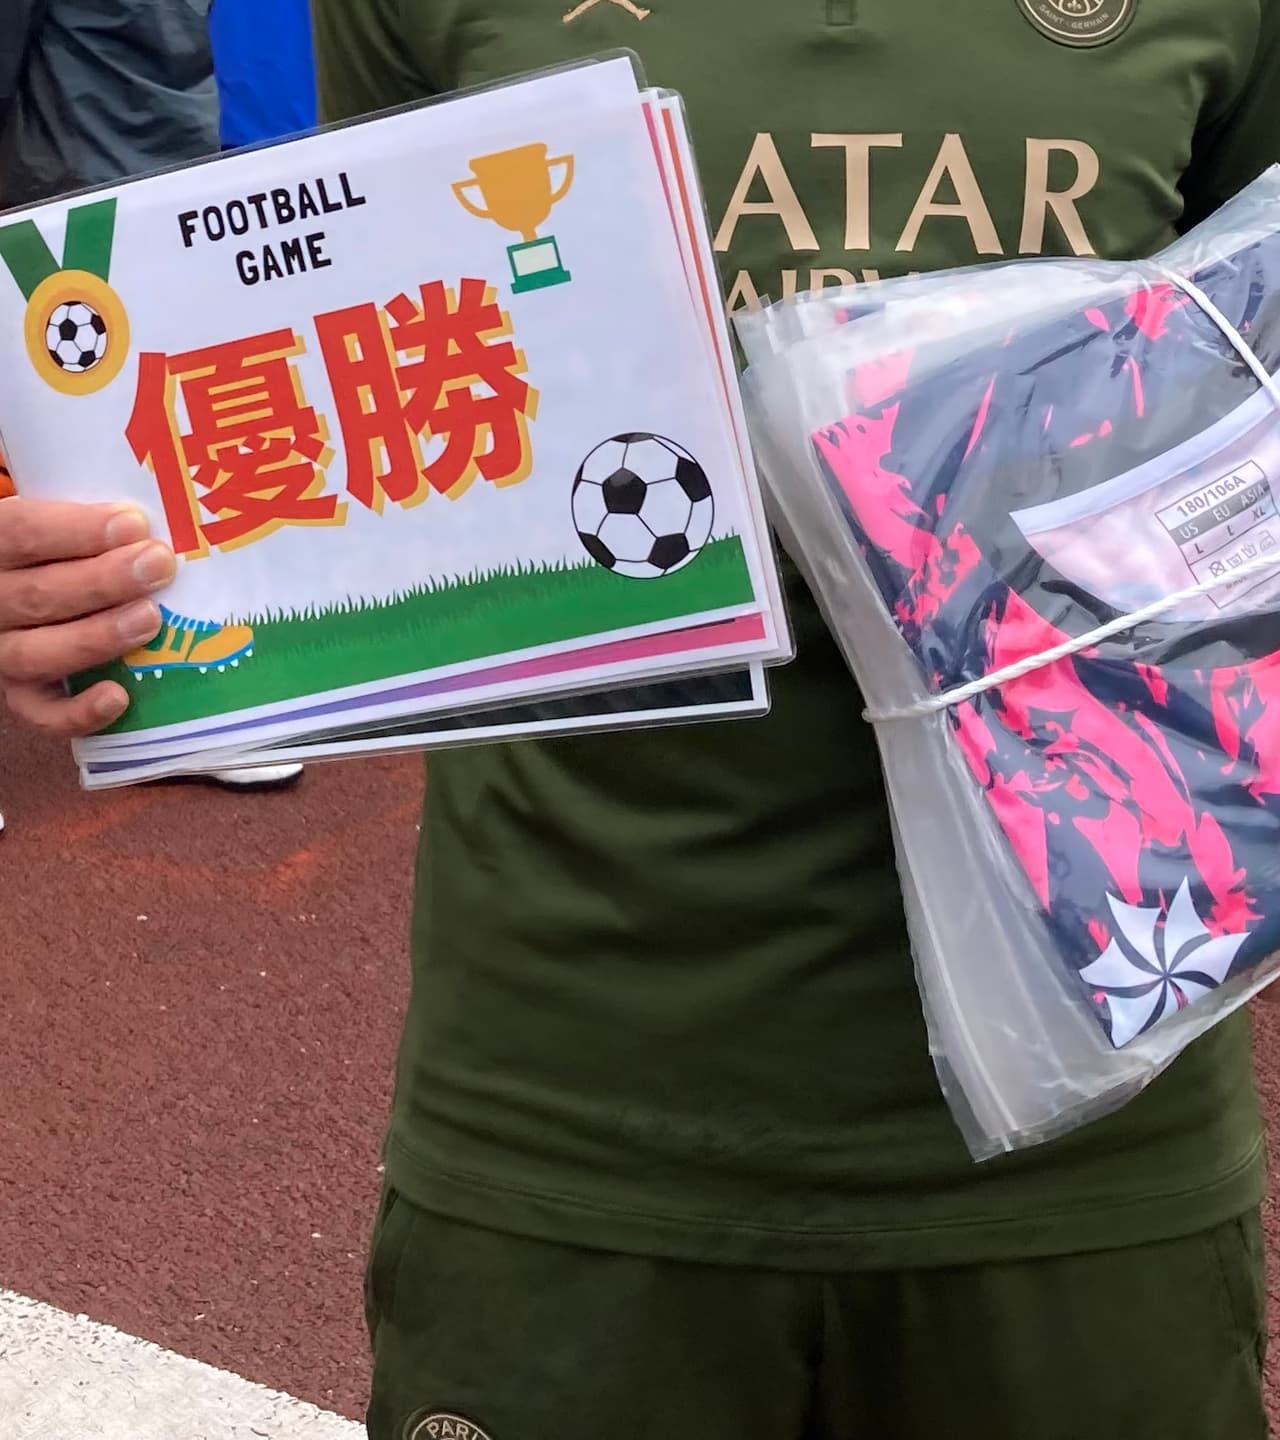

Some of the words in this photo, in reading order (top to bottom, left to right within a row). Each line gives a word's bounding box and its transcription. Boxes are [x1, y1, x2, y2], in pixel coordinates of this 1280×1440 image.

[177, 172, 367, 248] FOOTBALL
[713, 132, 1100, 256] ATAR
[235, 231, 333, 286] GAME
[124, 277, 540, 560] 優勝
[1176, 474, 1247, 517] 180/106A
[1180, 522, 1199, 539] US
[1212, 504, 1231, 521] EU
[1239, 483, 1266, 506] ASIA
[1194, 543, 1205, 554] L
[1226, 525, 1235, 537] L
[1251, 505, 1266, 521] XL
[426, 1420, 479, 1440] PARI
